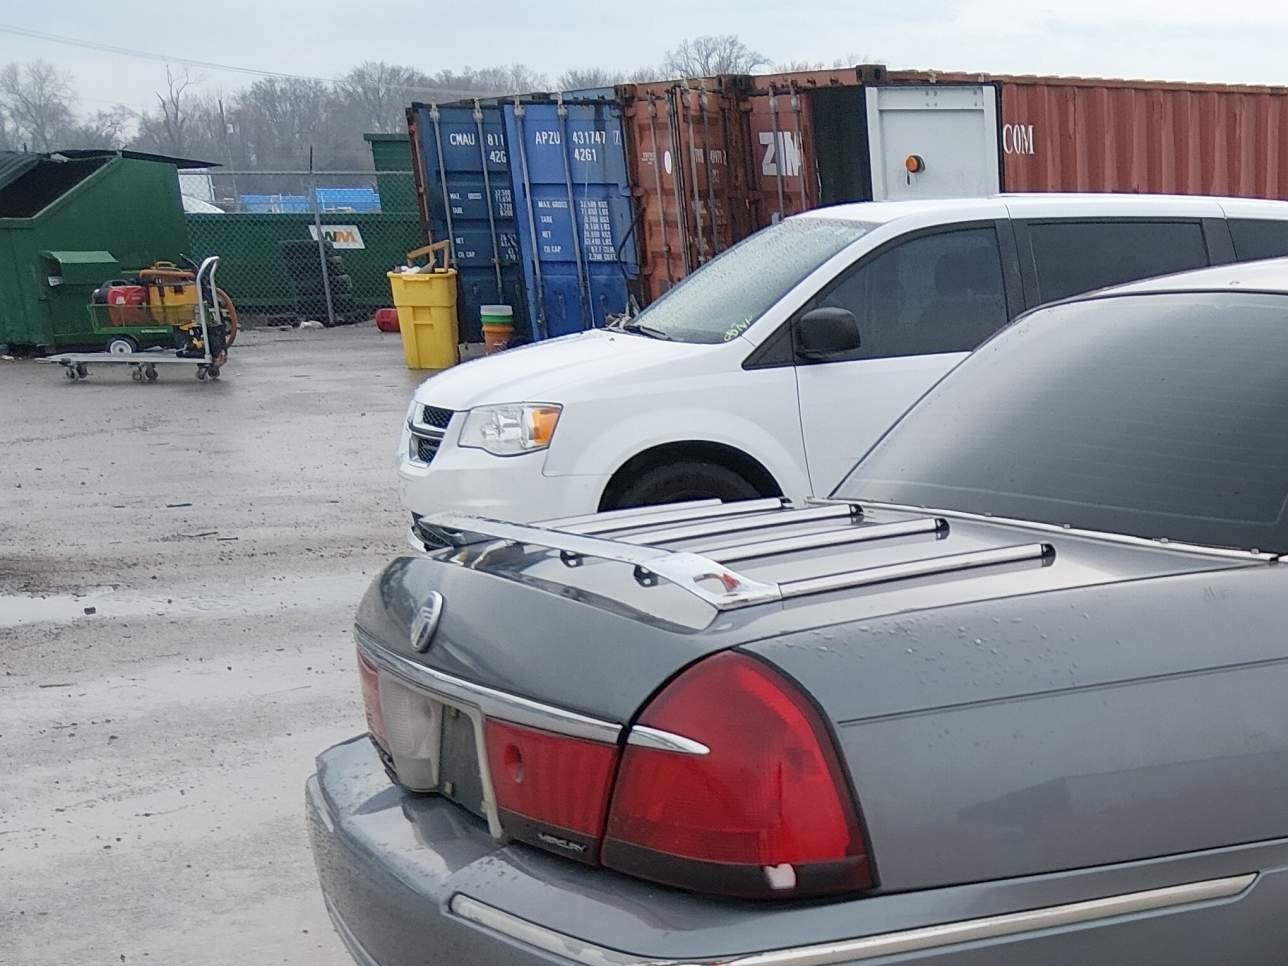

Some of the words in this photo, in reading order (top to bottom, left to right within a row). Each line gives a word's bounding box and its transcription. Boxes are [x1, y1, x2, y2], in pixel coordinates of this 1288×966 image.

[449, 132, 476, 146] CMAU
[487, 133, 504, 147] 811
[535, 130, 561, 145] APZU
[572, 130, 606, 145] 431747
